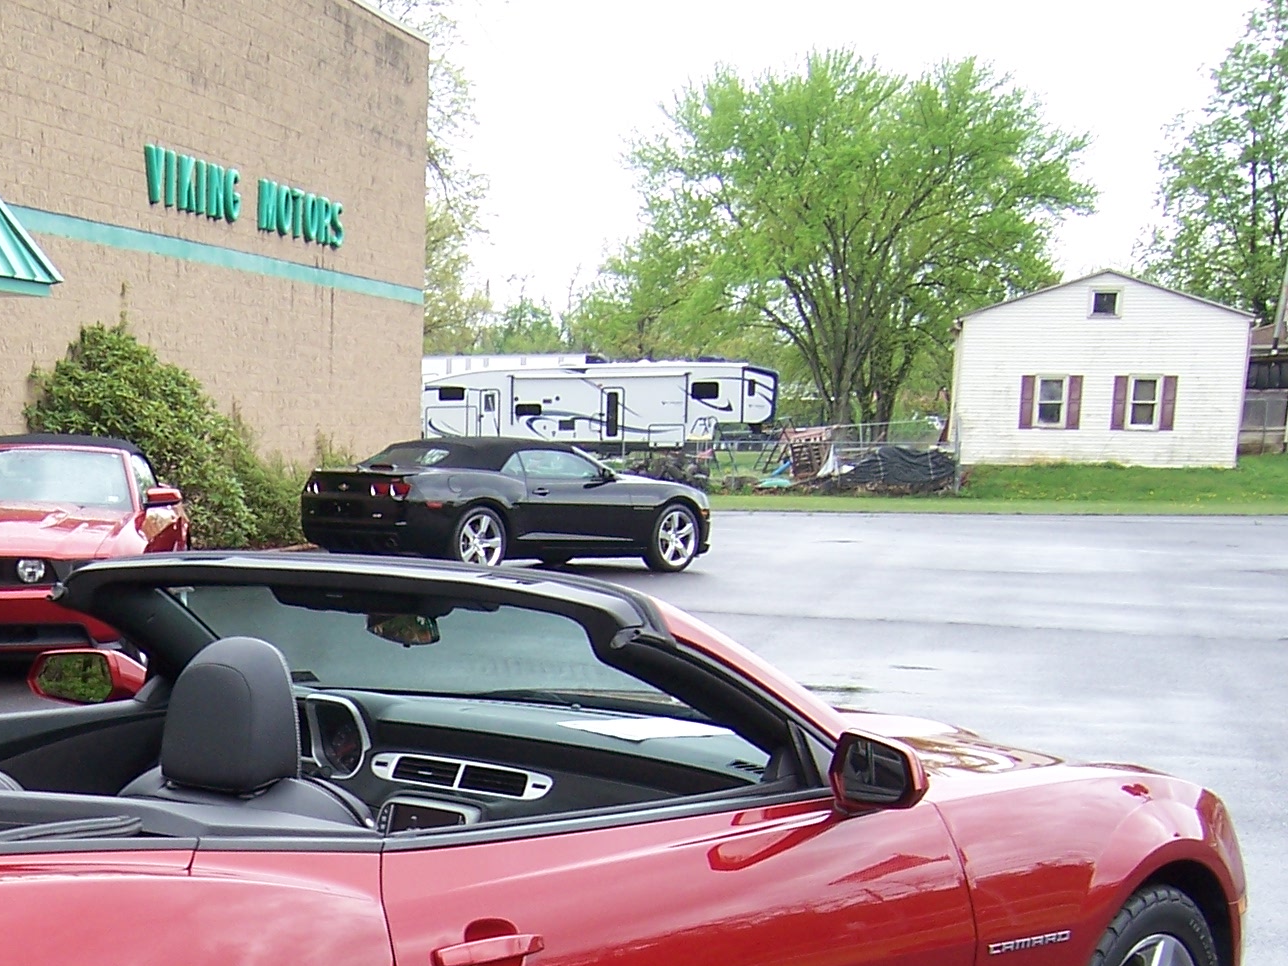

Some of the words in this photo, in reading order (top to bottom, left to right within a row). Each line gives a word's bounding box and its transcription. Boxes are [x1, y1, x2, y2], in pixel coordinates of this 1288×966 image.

[144, 143, 241, 223] VIKING
[257, 178, 344, 248] MOTORS
[988, 930, 1071, 954] CAMARO
